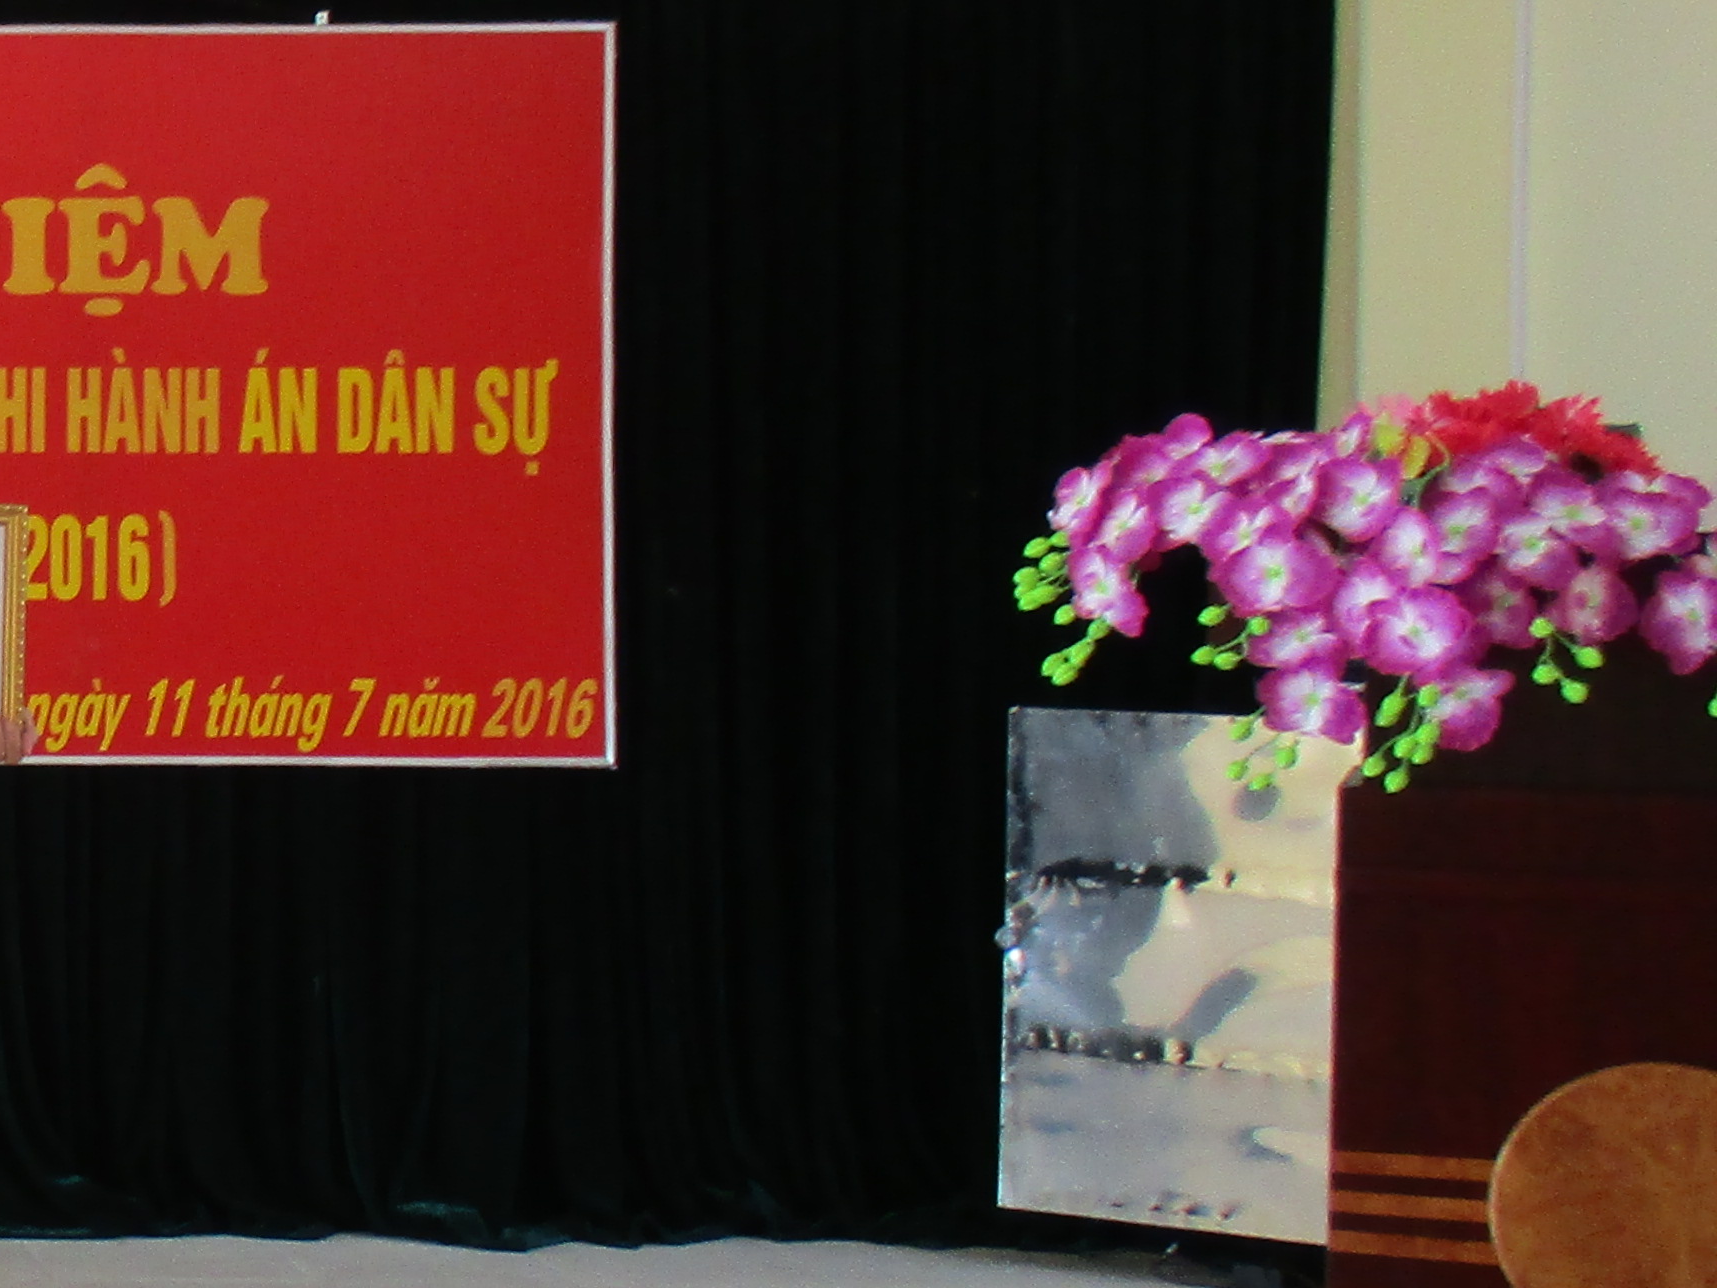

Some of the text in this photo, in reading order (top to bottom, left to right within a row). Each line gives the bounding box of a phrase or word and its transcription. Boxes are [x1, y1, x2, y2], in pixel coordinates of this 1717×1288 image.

[65, 347, 221, 454] HÀNH
[237, 347, 318, 454] ÁN
[336, 348, 456, 455] DÂN
[472, 358, 560, 475] SỰ
[26, 509, 178, 609] 2016)
[27, 674, 599, 754] ngày 11 tháng 7 năm 2016
